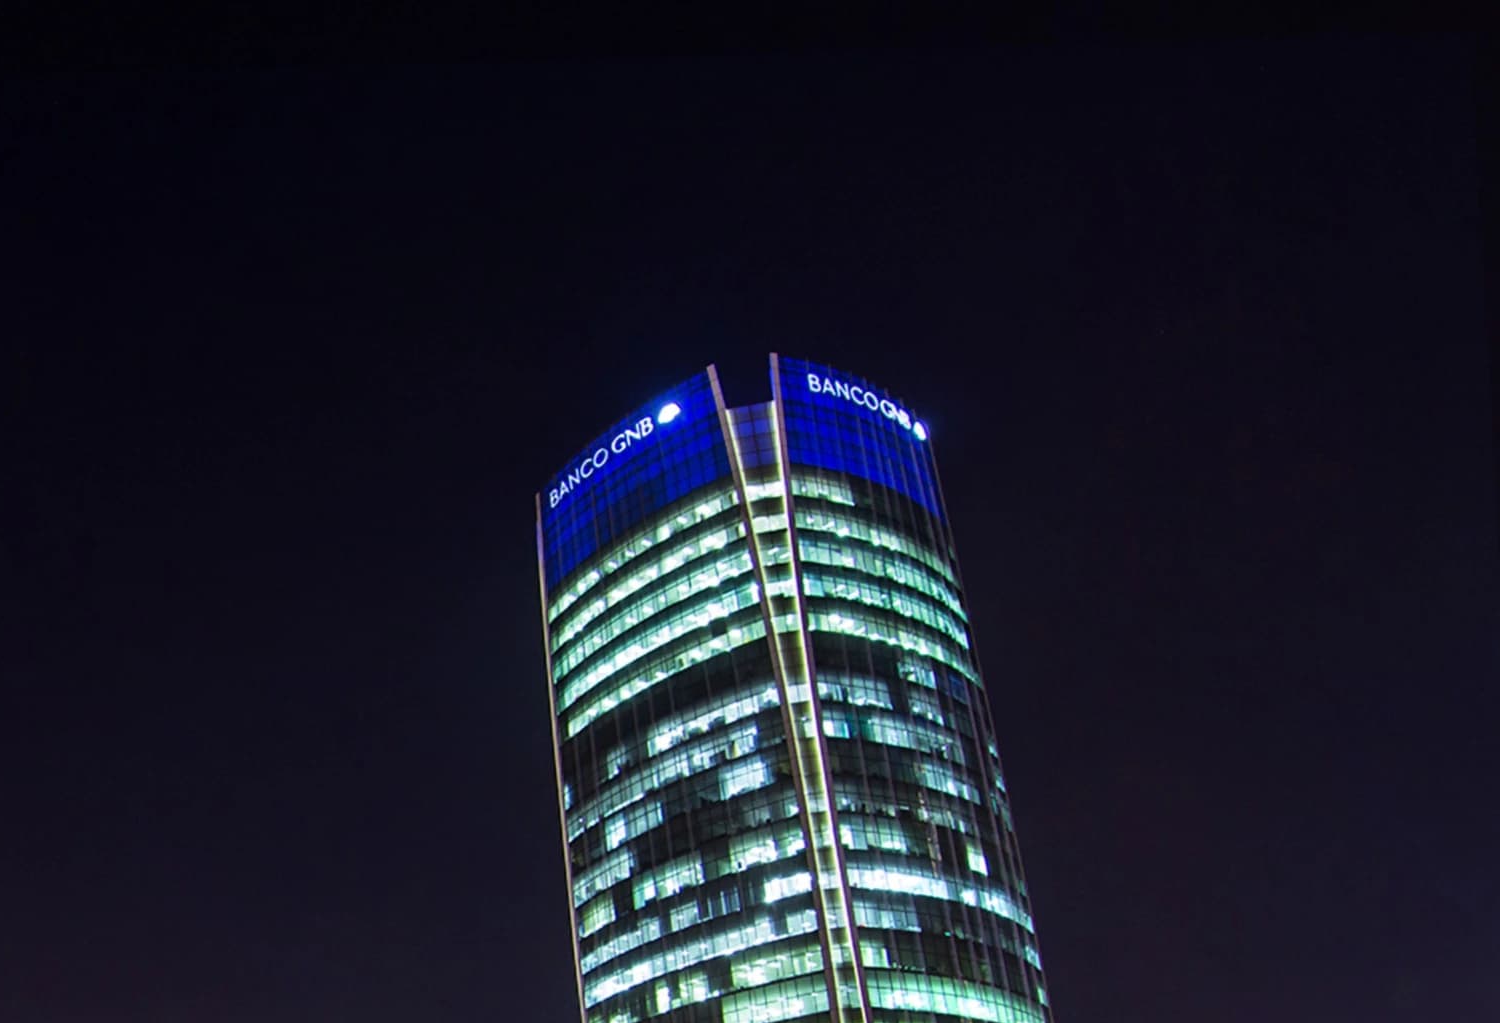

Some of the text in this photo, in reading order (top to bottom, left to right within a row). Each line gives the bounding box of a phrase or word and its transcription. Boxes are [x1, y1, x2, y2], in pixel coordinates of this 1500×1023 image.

[808, 373, 879, 411] BANCO
[549, 416, 654, 508] BANCO GNB
